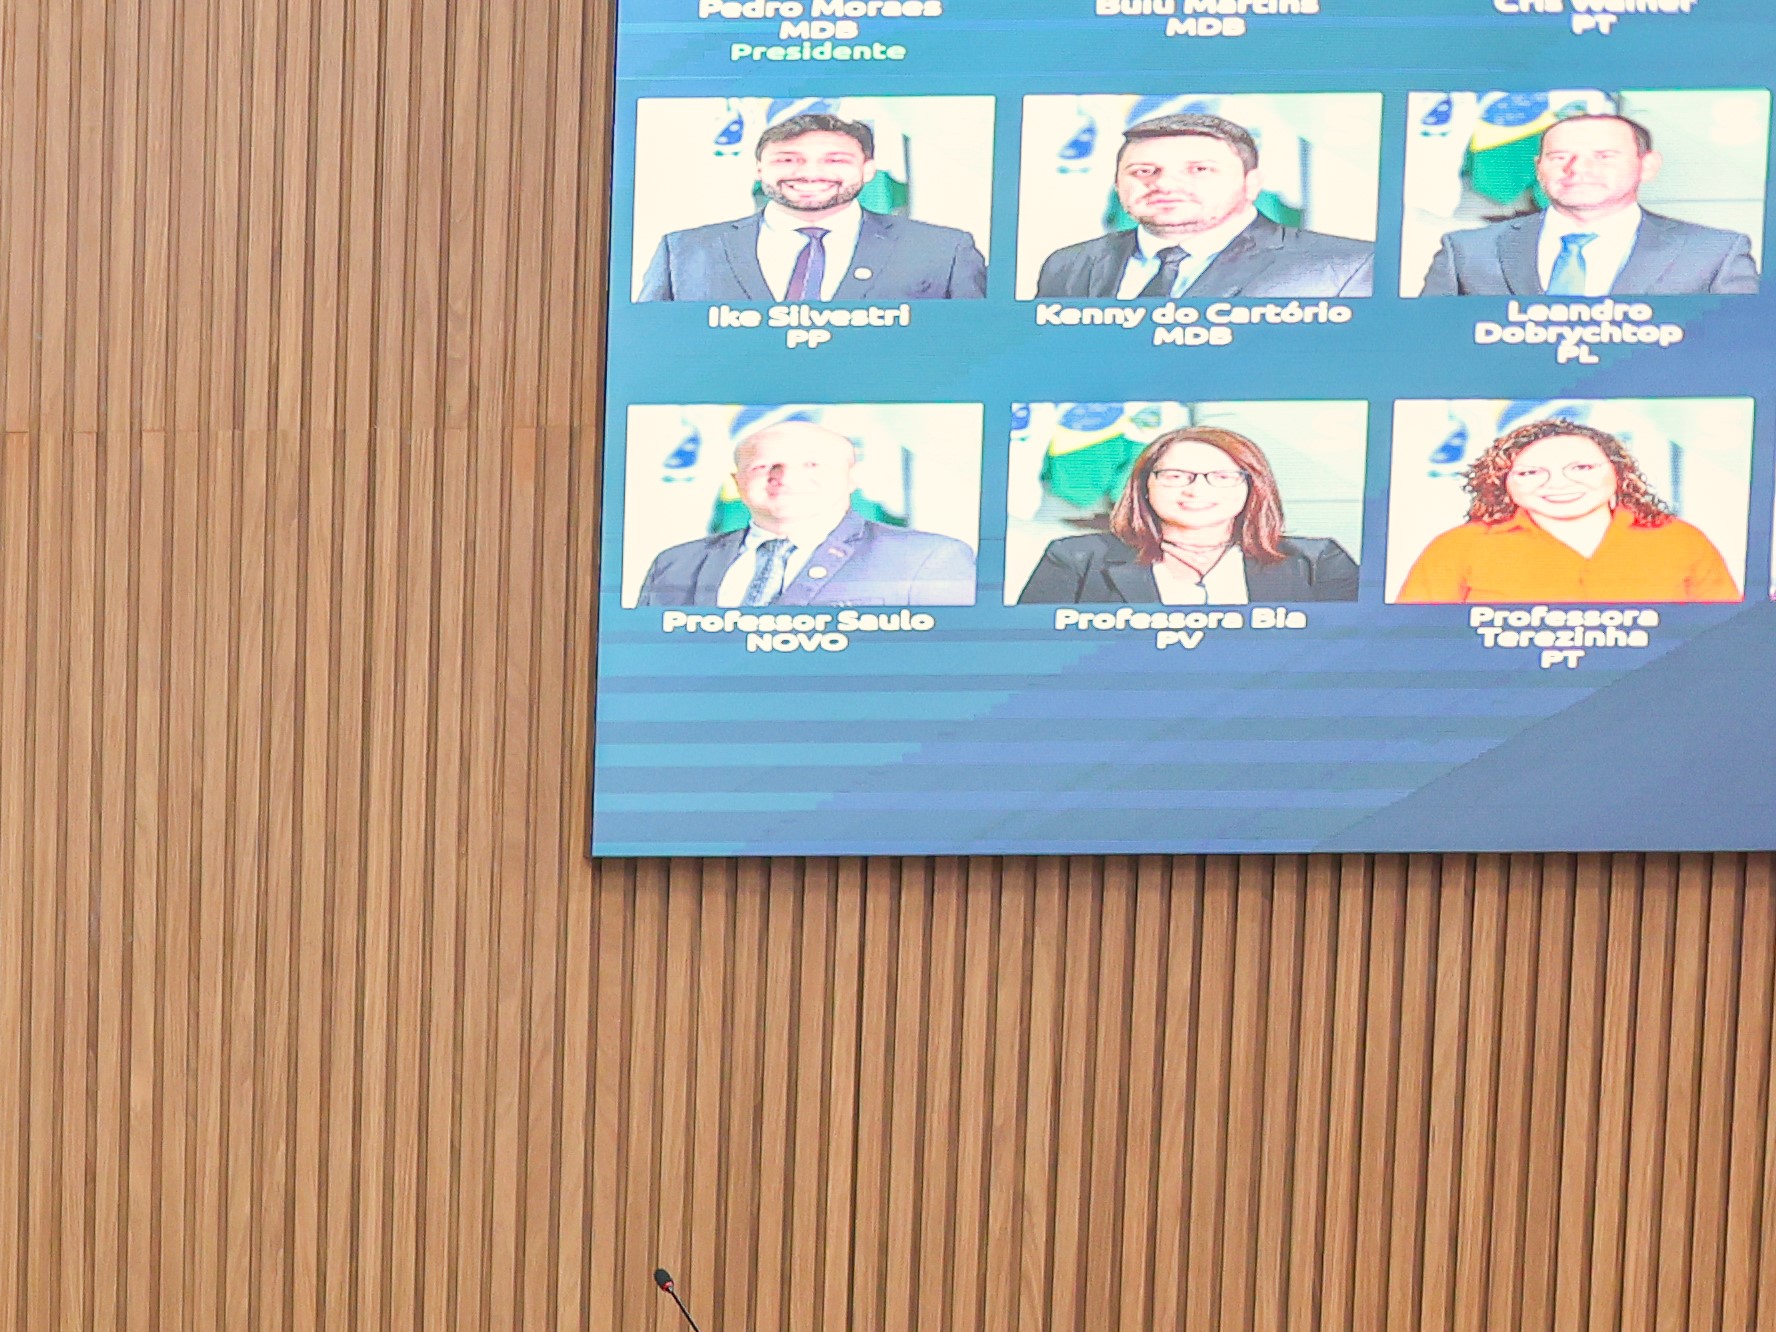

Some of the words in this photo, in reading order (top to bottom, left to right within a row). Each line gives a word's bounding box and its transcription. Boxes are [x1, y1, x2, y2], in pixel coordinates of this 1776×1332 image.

[698, 0, 803, 18] Pedro
[811, 0, 942, 17] Moraes
[779, 20, 858, 40] MDB
[1165, 17, 1246, 37] MDB
[1571, 13, 1618, 35] PT
[730, 41, 906, 61] Presidente
[708, 305, 761, 328] Ike
[768, 304, 911, 327] Silvestri
[1035, 303, 1147, 329] Kenny
[1152, 302, 1199, 325] do
[1205, 301, 1352, 324] Cartório
[1508, 299, 1653, 322] Leandro
[786, 329, 832, 349] PP
[1153, 326, 1233, 346] MDB
[1474, 321, 1684, 347] Dobrychtop
[1556, 344, 1600, 364] PL
[662, 610, 832, 633] Professor
[837, 609, 935, 631] Saulo
[1055, 607, 1243, 630] Professora
[1251, 607, 1307, 629] Bia
[1469, 606, 1660, 627] Professora
[746, 633, 849, 652] NOVO
[1155, 630, 1205, 649] PV
[1477, 626, 1649, 648] Terezinha
[1540, 649, 1586, 669] PT
